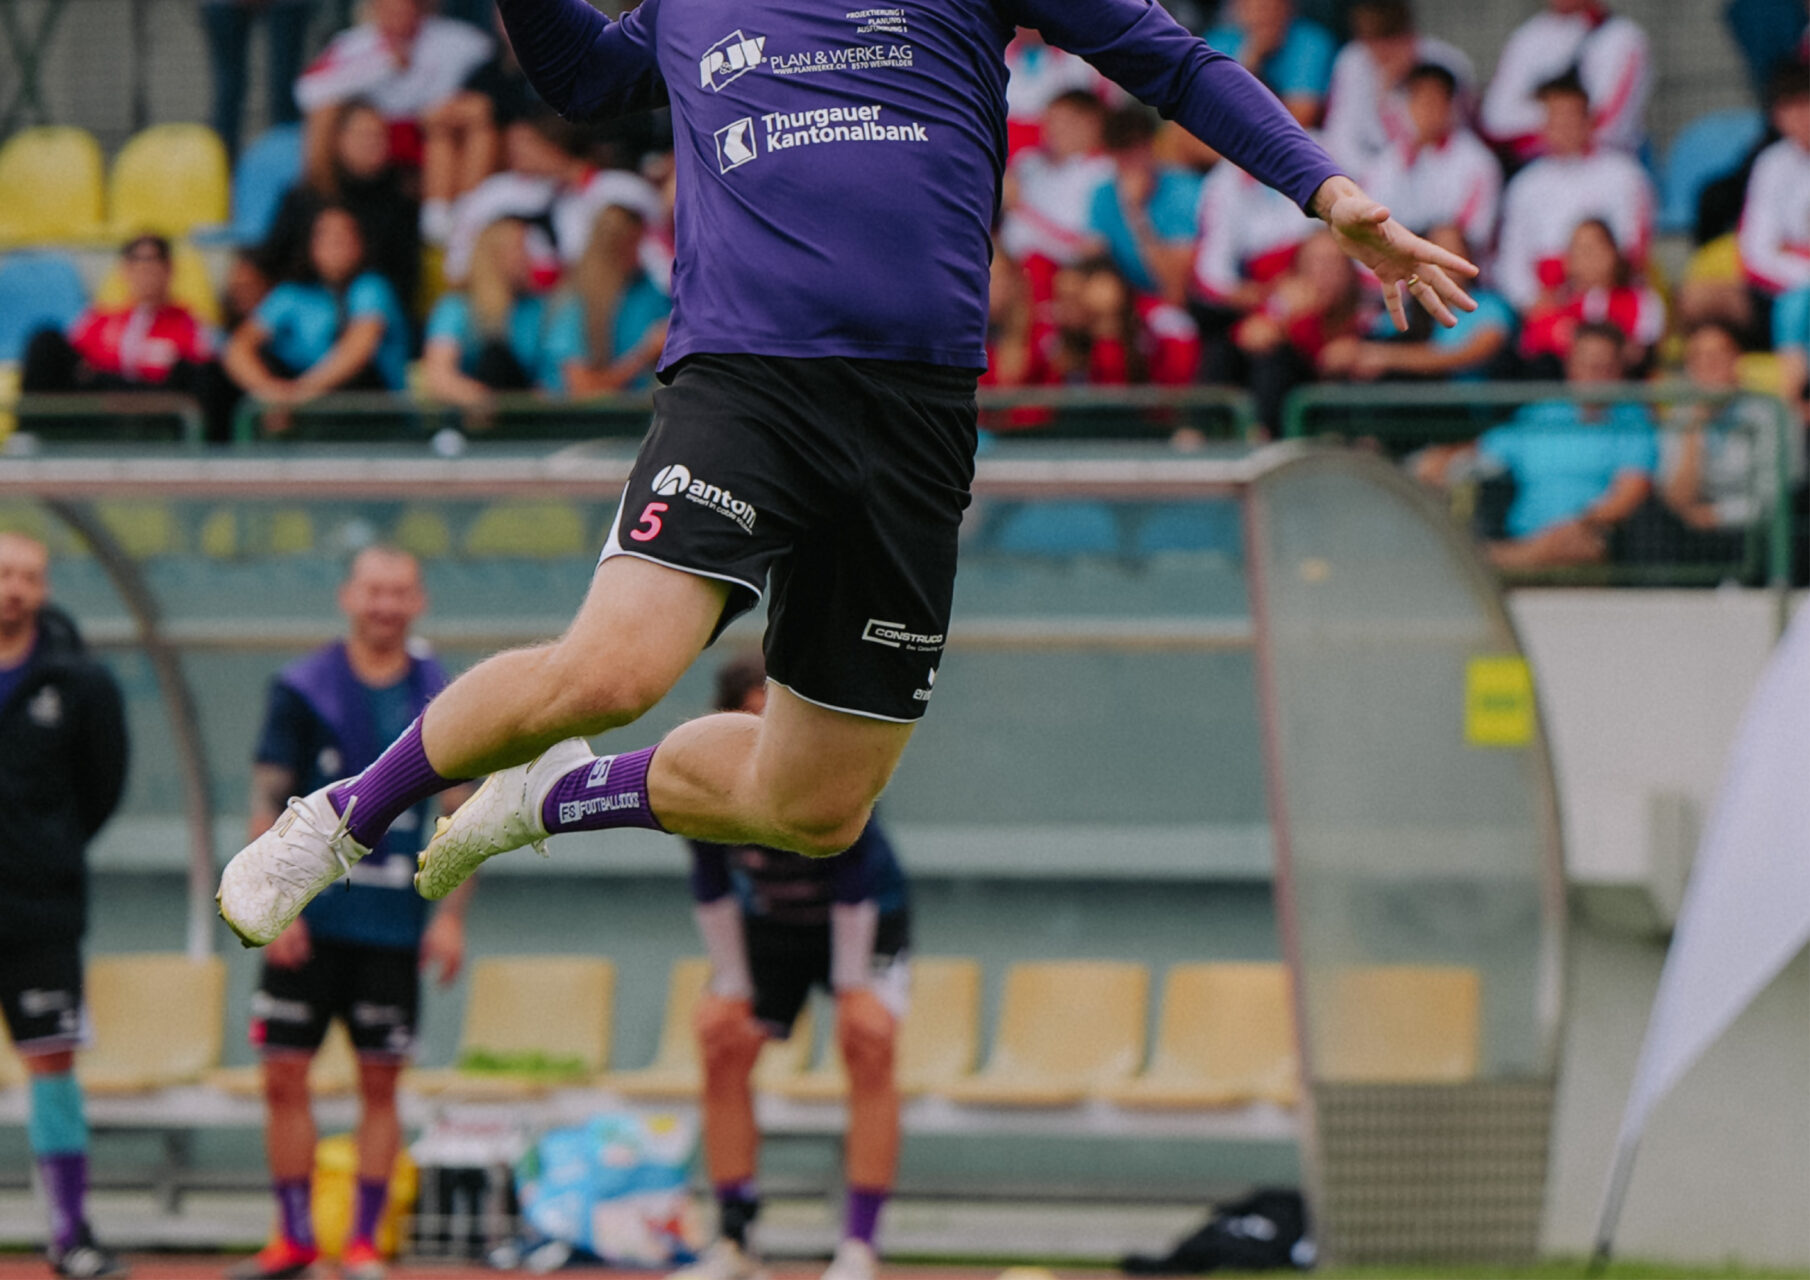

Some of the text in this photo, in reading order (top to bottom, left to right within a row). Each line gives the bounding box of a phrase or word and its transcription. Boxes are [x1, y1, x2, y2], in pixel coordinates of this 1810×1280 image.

[770, 45, 913, 69] PLAN & WERKE AG
[761, 105, 882, 133] Thurgauer
[767, 122, 929, 153] Kantonalbank
[630, 502, 669, 542] 5
